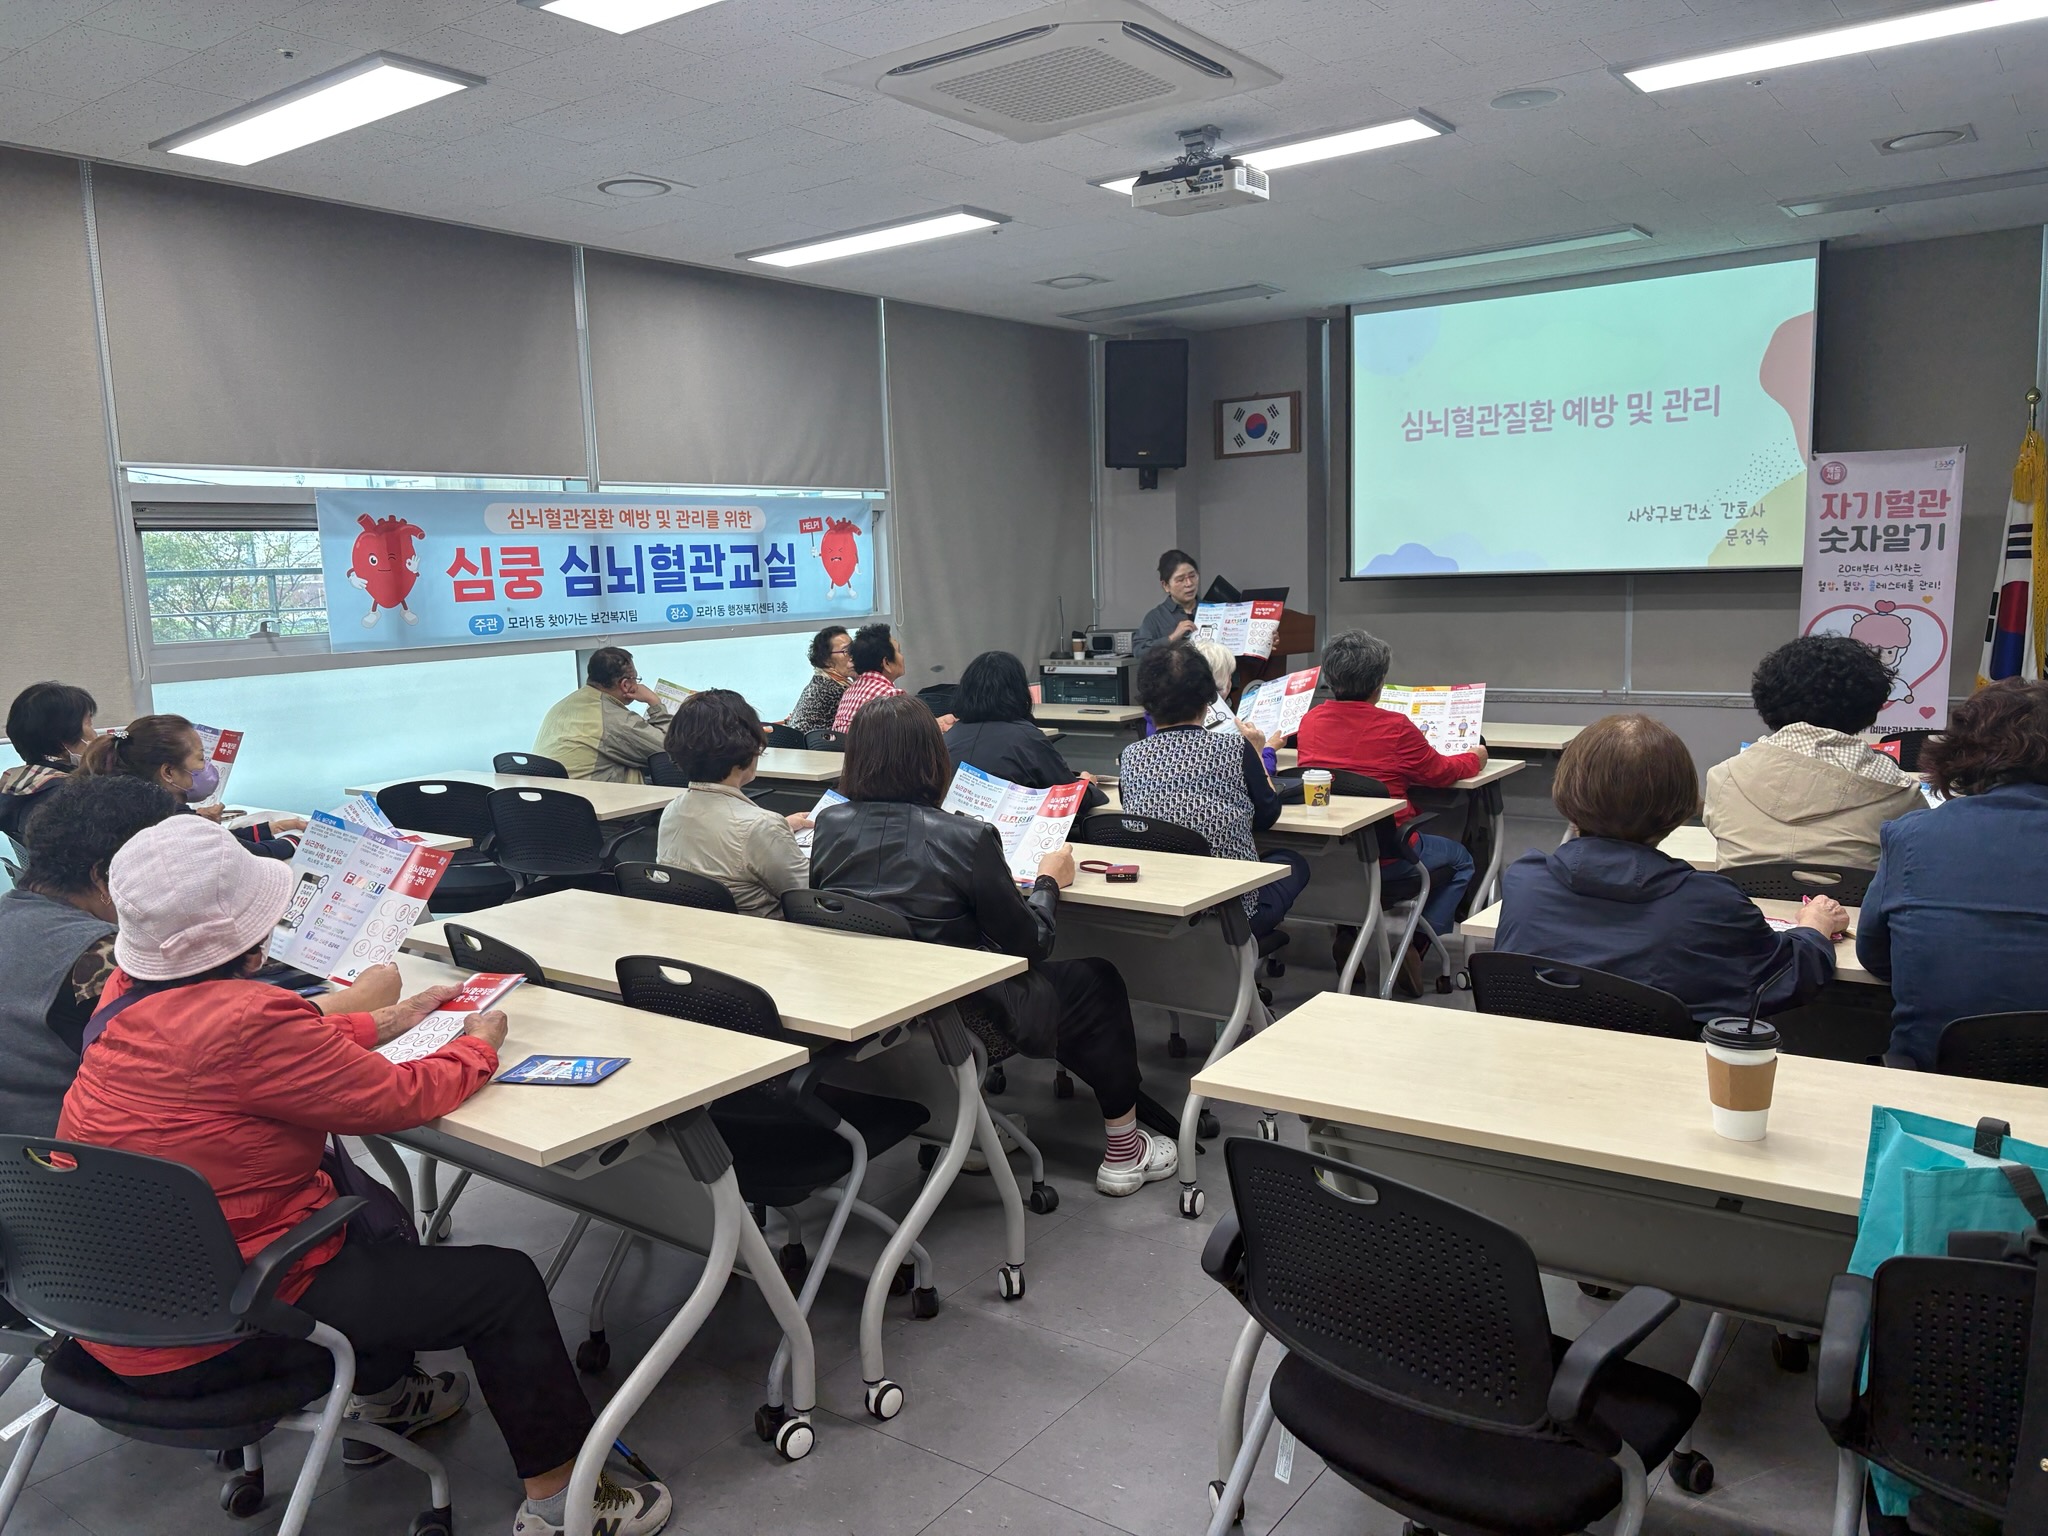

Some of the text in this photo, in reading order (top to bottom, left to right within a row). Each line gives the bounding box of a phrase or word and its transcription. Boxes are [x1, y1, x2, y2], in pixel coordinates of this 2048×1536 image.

[1401, 384, 1721, 442] 심뇌혈관질환 예방 및 관리
[1627, 501, 1766, 523] 사상구보건소 간호사
[1819, 488, 1951, 520] 자기혈관
[507, 508, 752, 530] 심뇌혈관질환 예방 및 관리를 위한
[1725, 527, 1769, 547] 문정숙
[1818, 522, 1946, 554] 숫자알기
[446, 542, 798, 604] 심쿵 심뇌혈관교실
[1838, 562, 1922, 574] 20대부터 시작하는
[474, 609, 639, 633] 주관 모라1동 찾아가는 보건복지팀
[670, 600, 789, 620] 장소 모라1동 행정복지센터 3층
